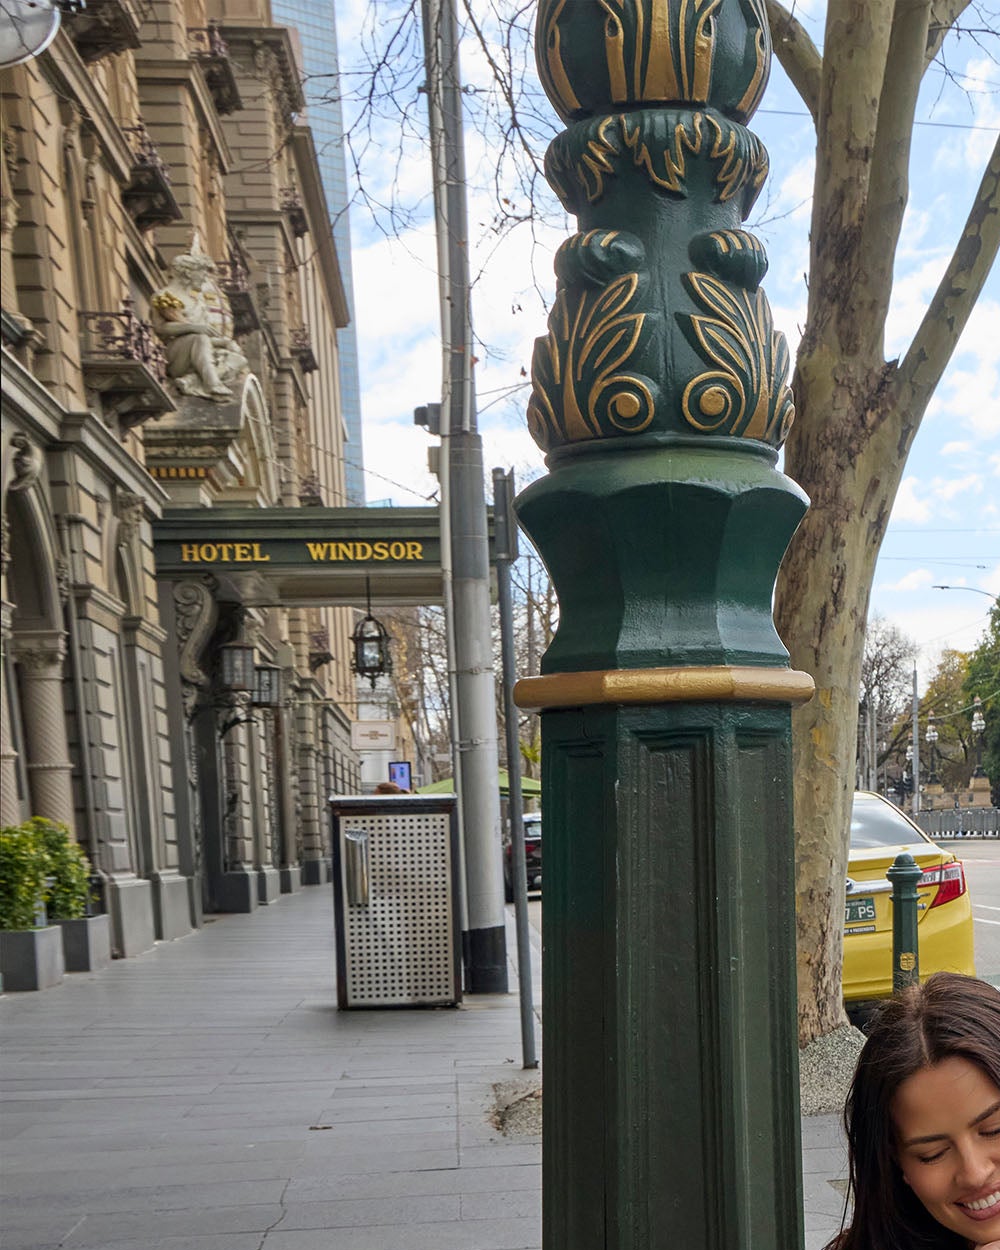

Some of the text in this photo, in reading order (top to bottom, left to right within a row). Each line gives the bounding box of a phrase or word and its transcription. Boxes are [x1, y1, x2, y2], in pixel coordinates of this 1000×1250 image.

[181, 541, 424, 562] HOTEL WINDSOR
[858, 906, 875, 918] PS
